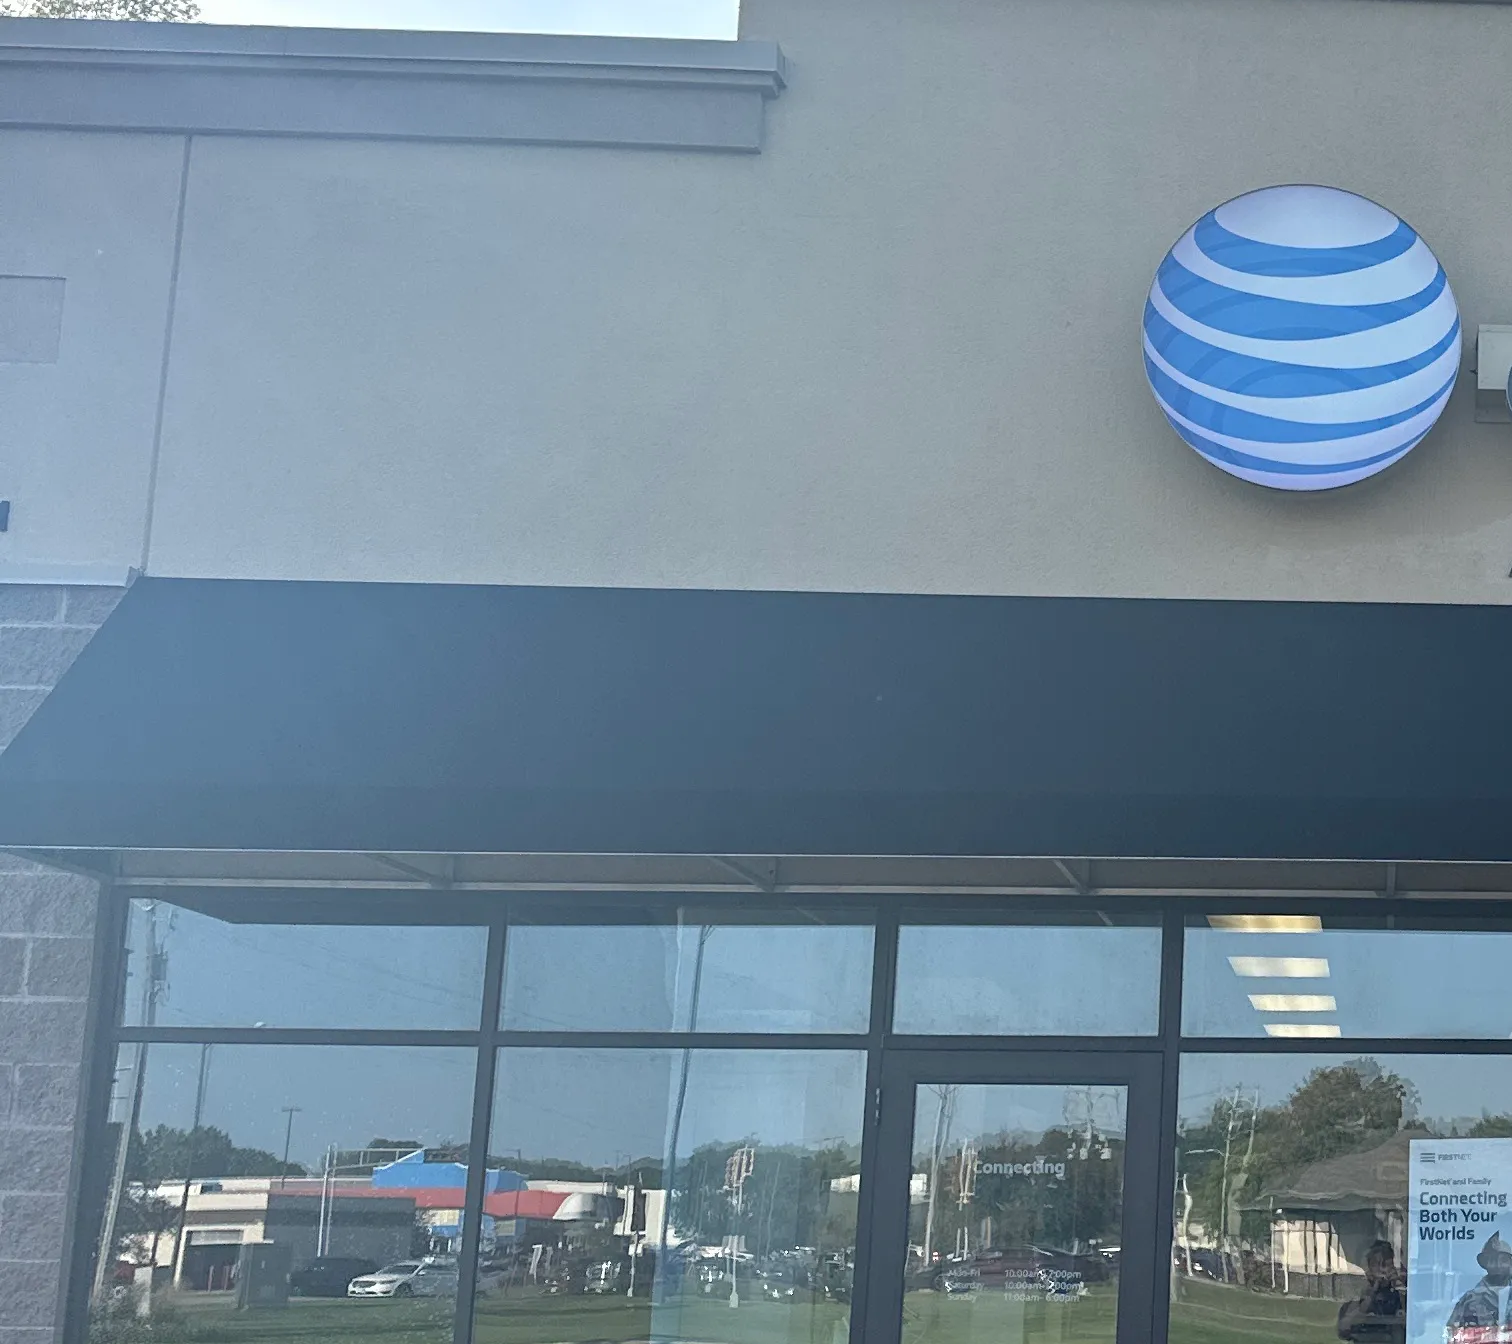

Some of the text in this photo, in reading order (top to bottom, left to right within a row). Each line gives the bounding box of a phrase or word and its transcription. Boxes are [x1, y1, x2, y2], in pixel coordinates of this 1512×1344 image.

[974, 1160, 1065, 1179] Connecting
[1420, 1191, 1507, 1207] Connecting
[1420, 1209, 1498, 1223] Both Your
[1420, 1226, 1475, 1241] Worlds
[1047, 1281, 1080, 1291] :00pm
[947, 1293, 978, 1303] Sunday
